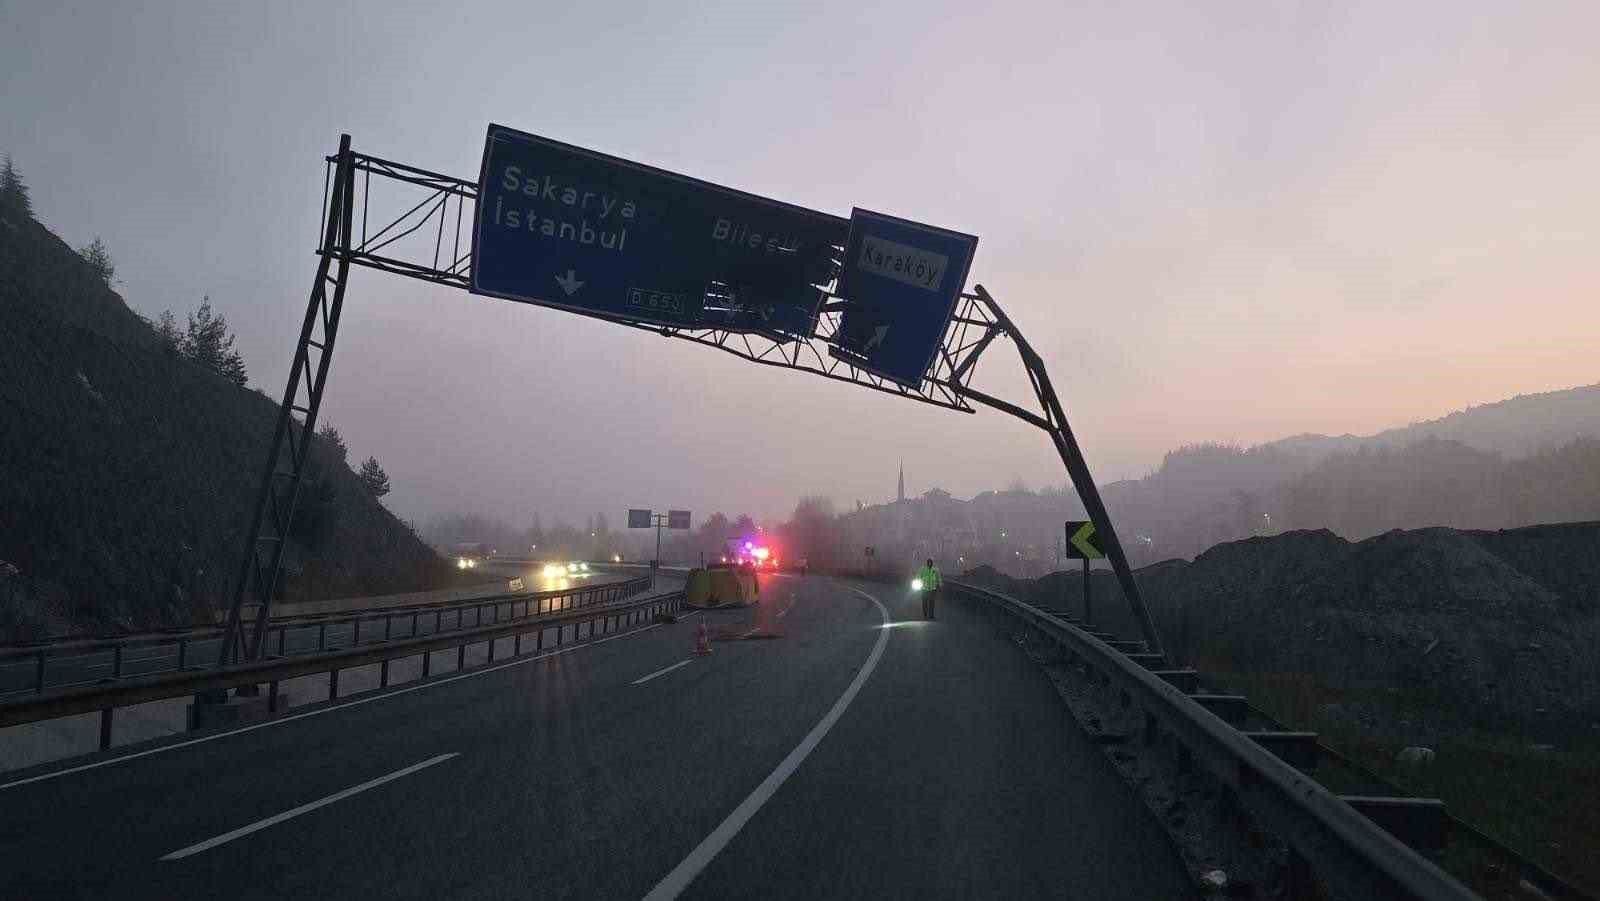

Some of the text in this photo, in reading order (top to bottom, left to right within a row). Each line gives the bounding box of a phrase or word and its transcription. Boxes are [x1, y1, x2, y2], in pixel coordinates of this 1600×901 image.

[502, 165, 637, 219] Sakarya
[495, 195, 627, 251] İstanbul
[863, 241, 938, 285] Karaköy
